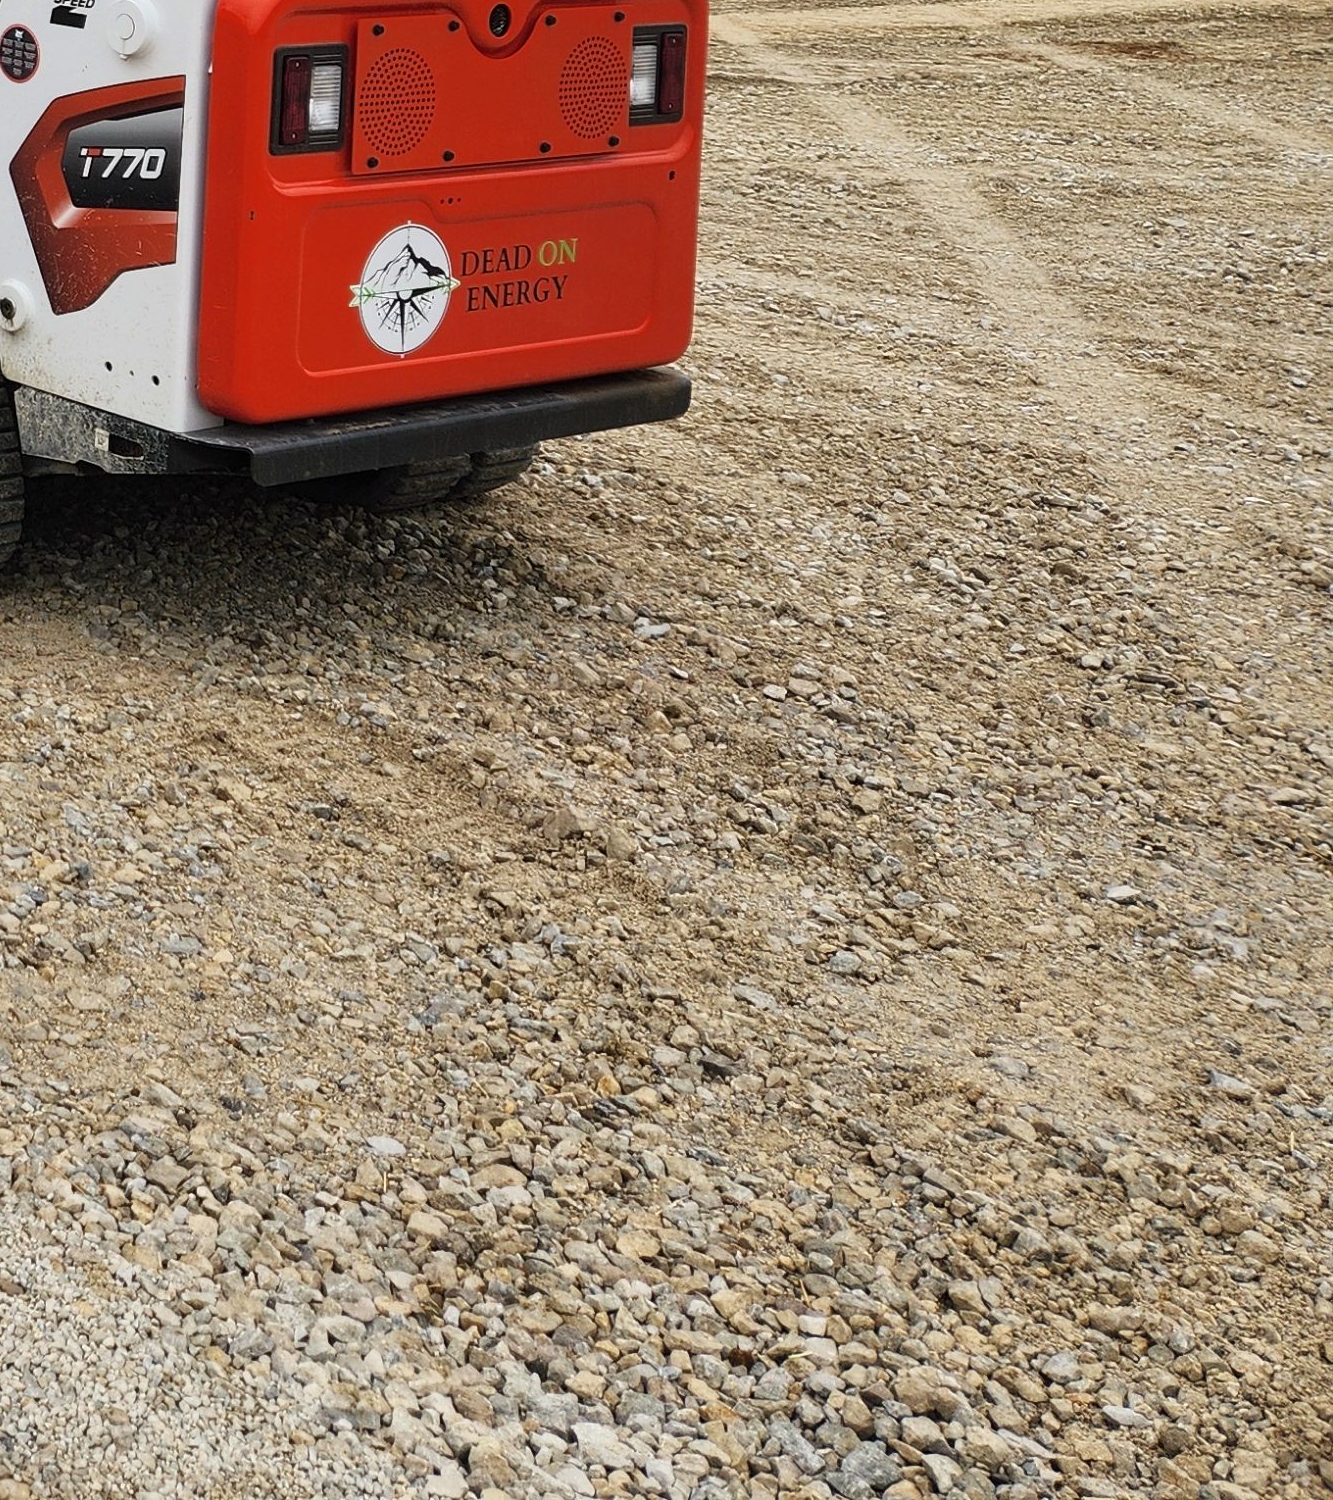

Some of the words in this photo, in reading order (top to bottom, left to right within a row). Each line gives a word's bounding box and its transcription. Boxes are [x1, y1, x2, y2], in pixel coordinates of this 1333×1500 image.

[80, 147, 167, 180] T770
[461, 244, 532, 277] DEAD
[538, 237, 579, 267] ON
[466, 274, 570, 313] ENERGY
